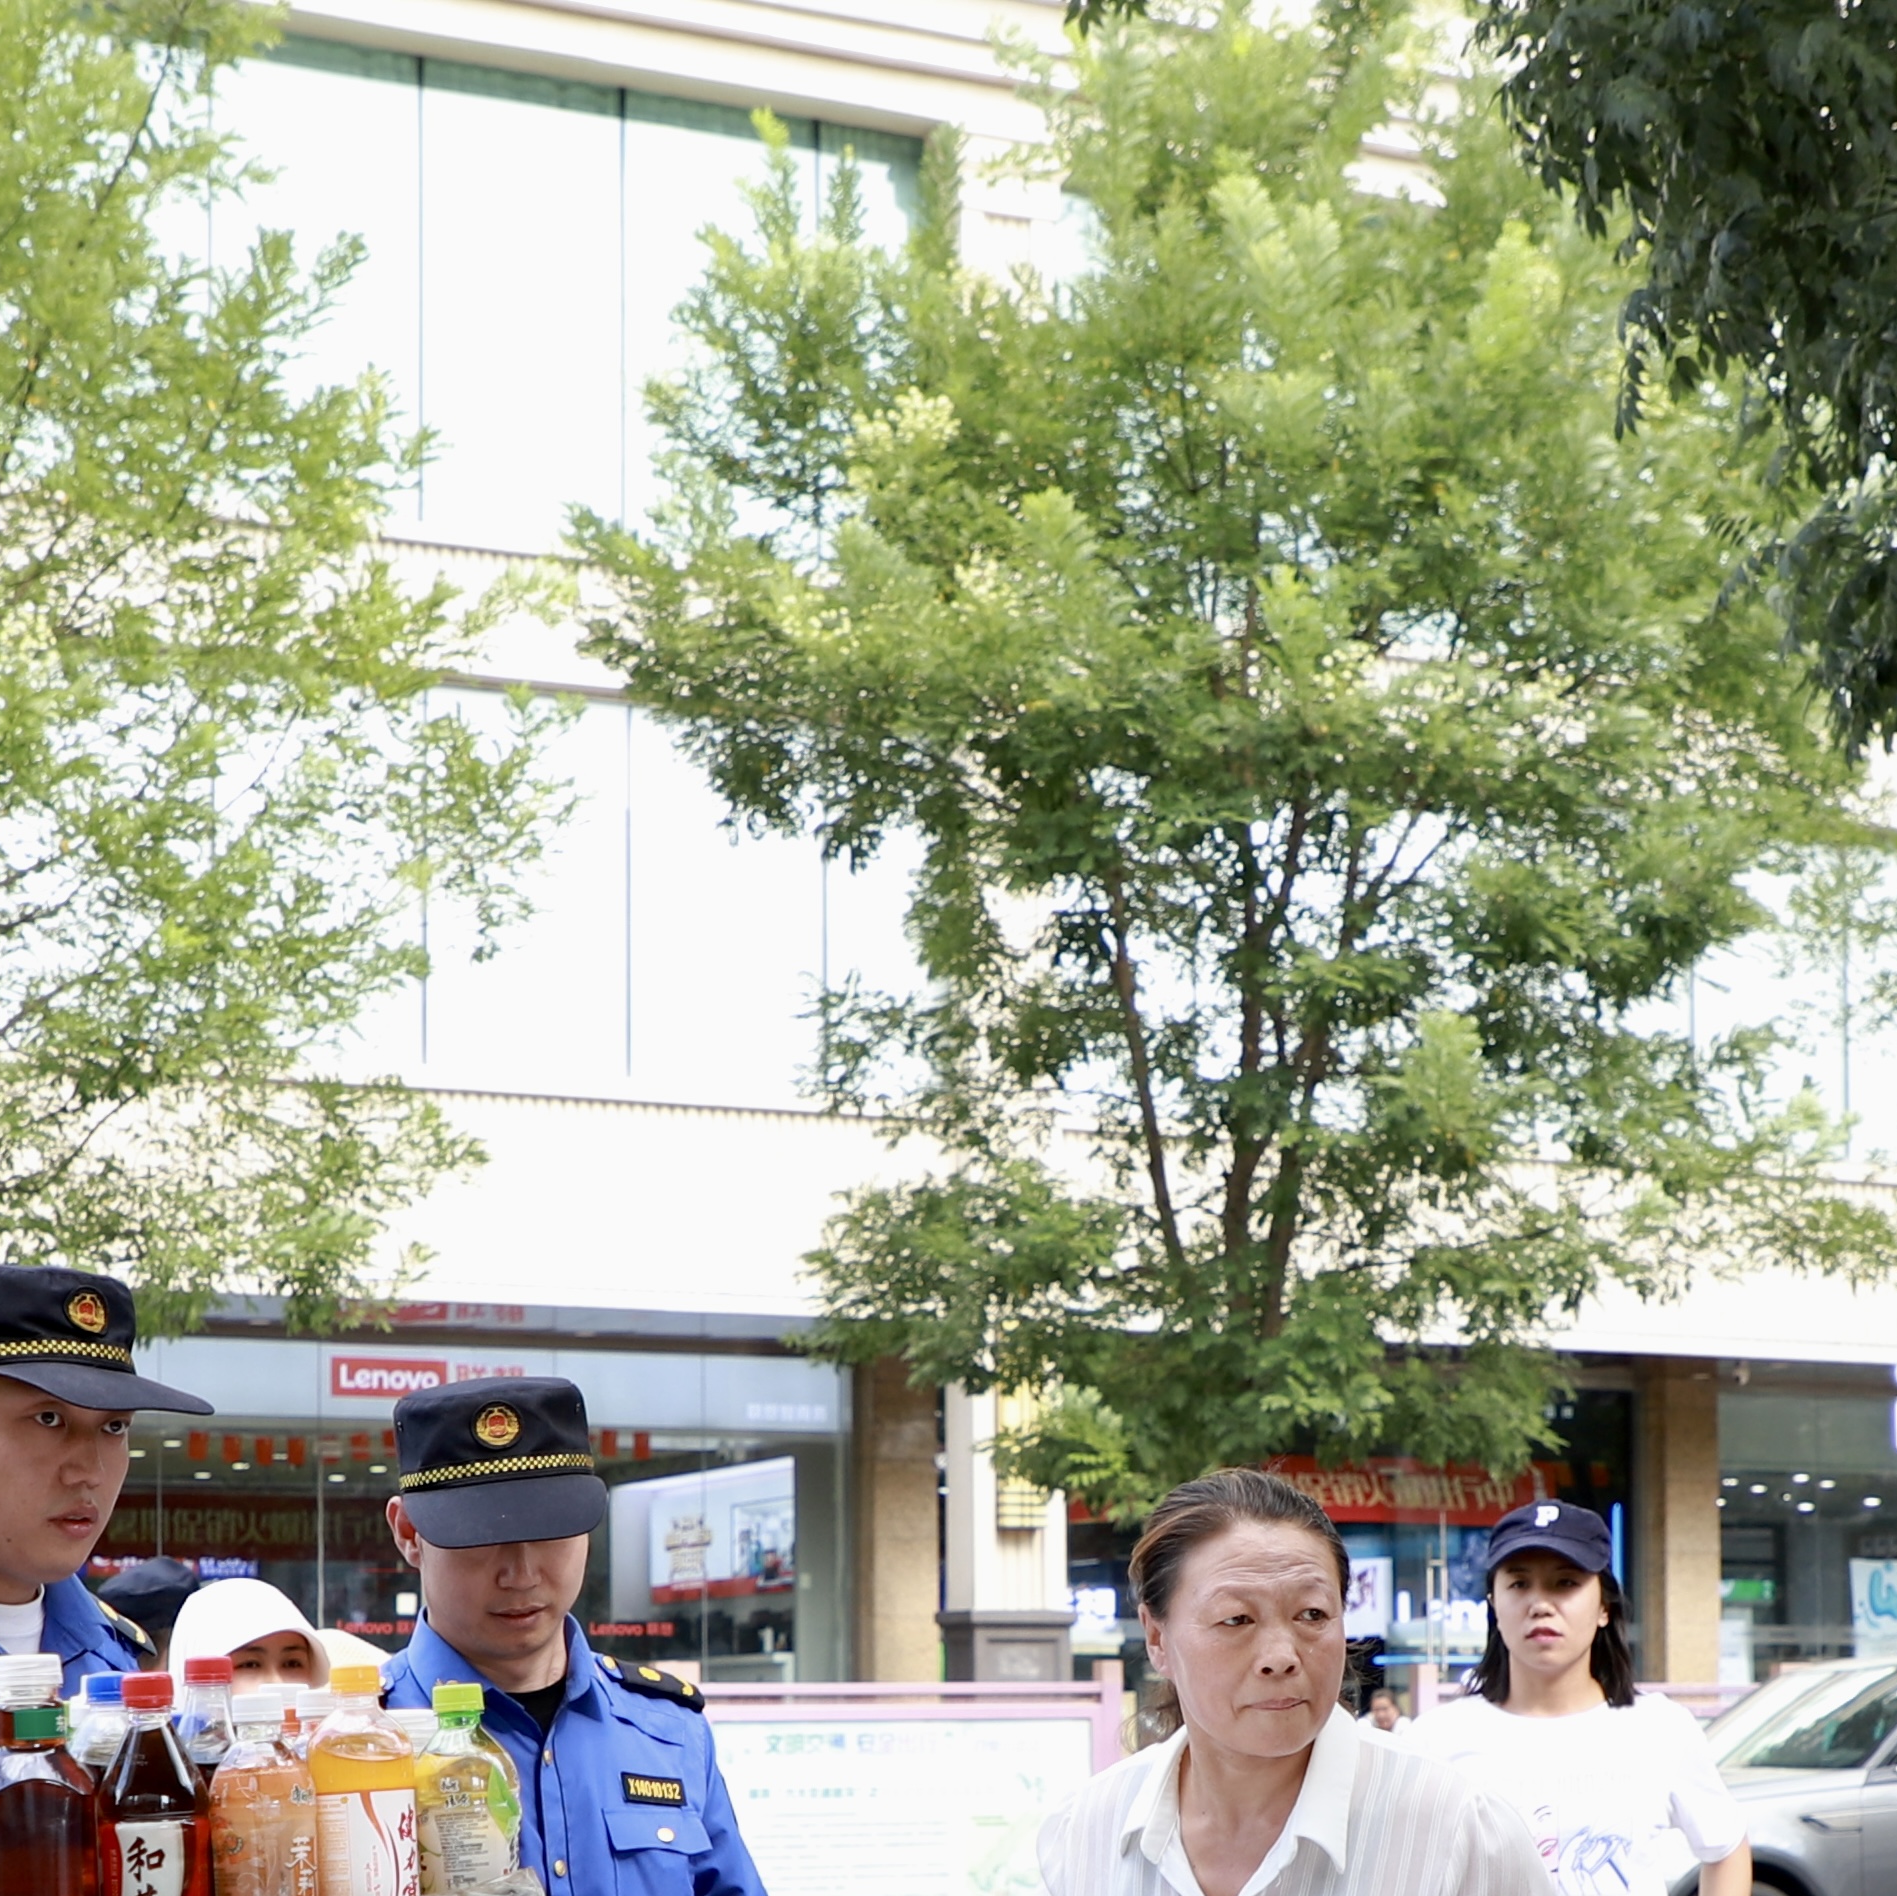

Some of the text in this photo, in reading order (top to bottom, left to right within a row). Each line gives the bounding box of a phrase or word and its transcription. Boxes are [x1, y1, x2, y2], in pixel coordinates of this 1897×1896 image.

[340, 1364, 440, 1390] Lenovo
[1534, 1505, 1561, 1528] P
[336, 1620, 392, 1635] Lenovo
[589, 1621, 643, 1636] Lenovo
[627, 1777, 682, 1800] X14010132
